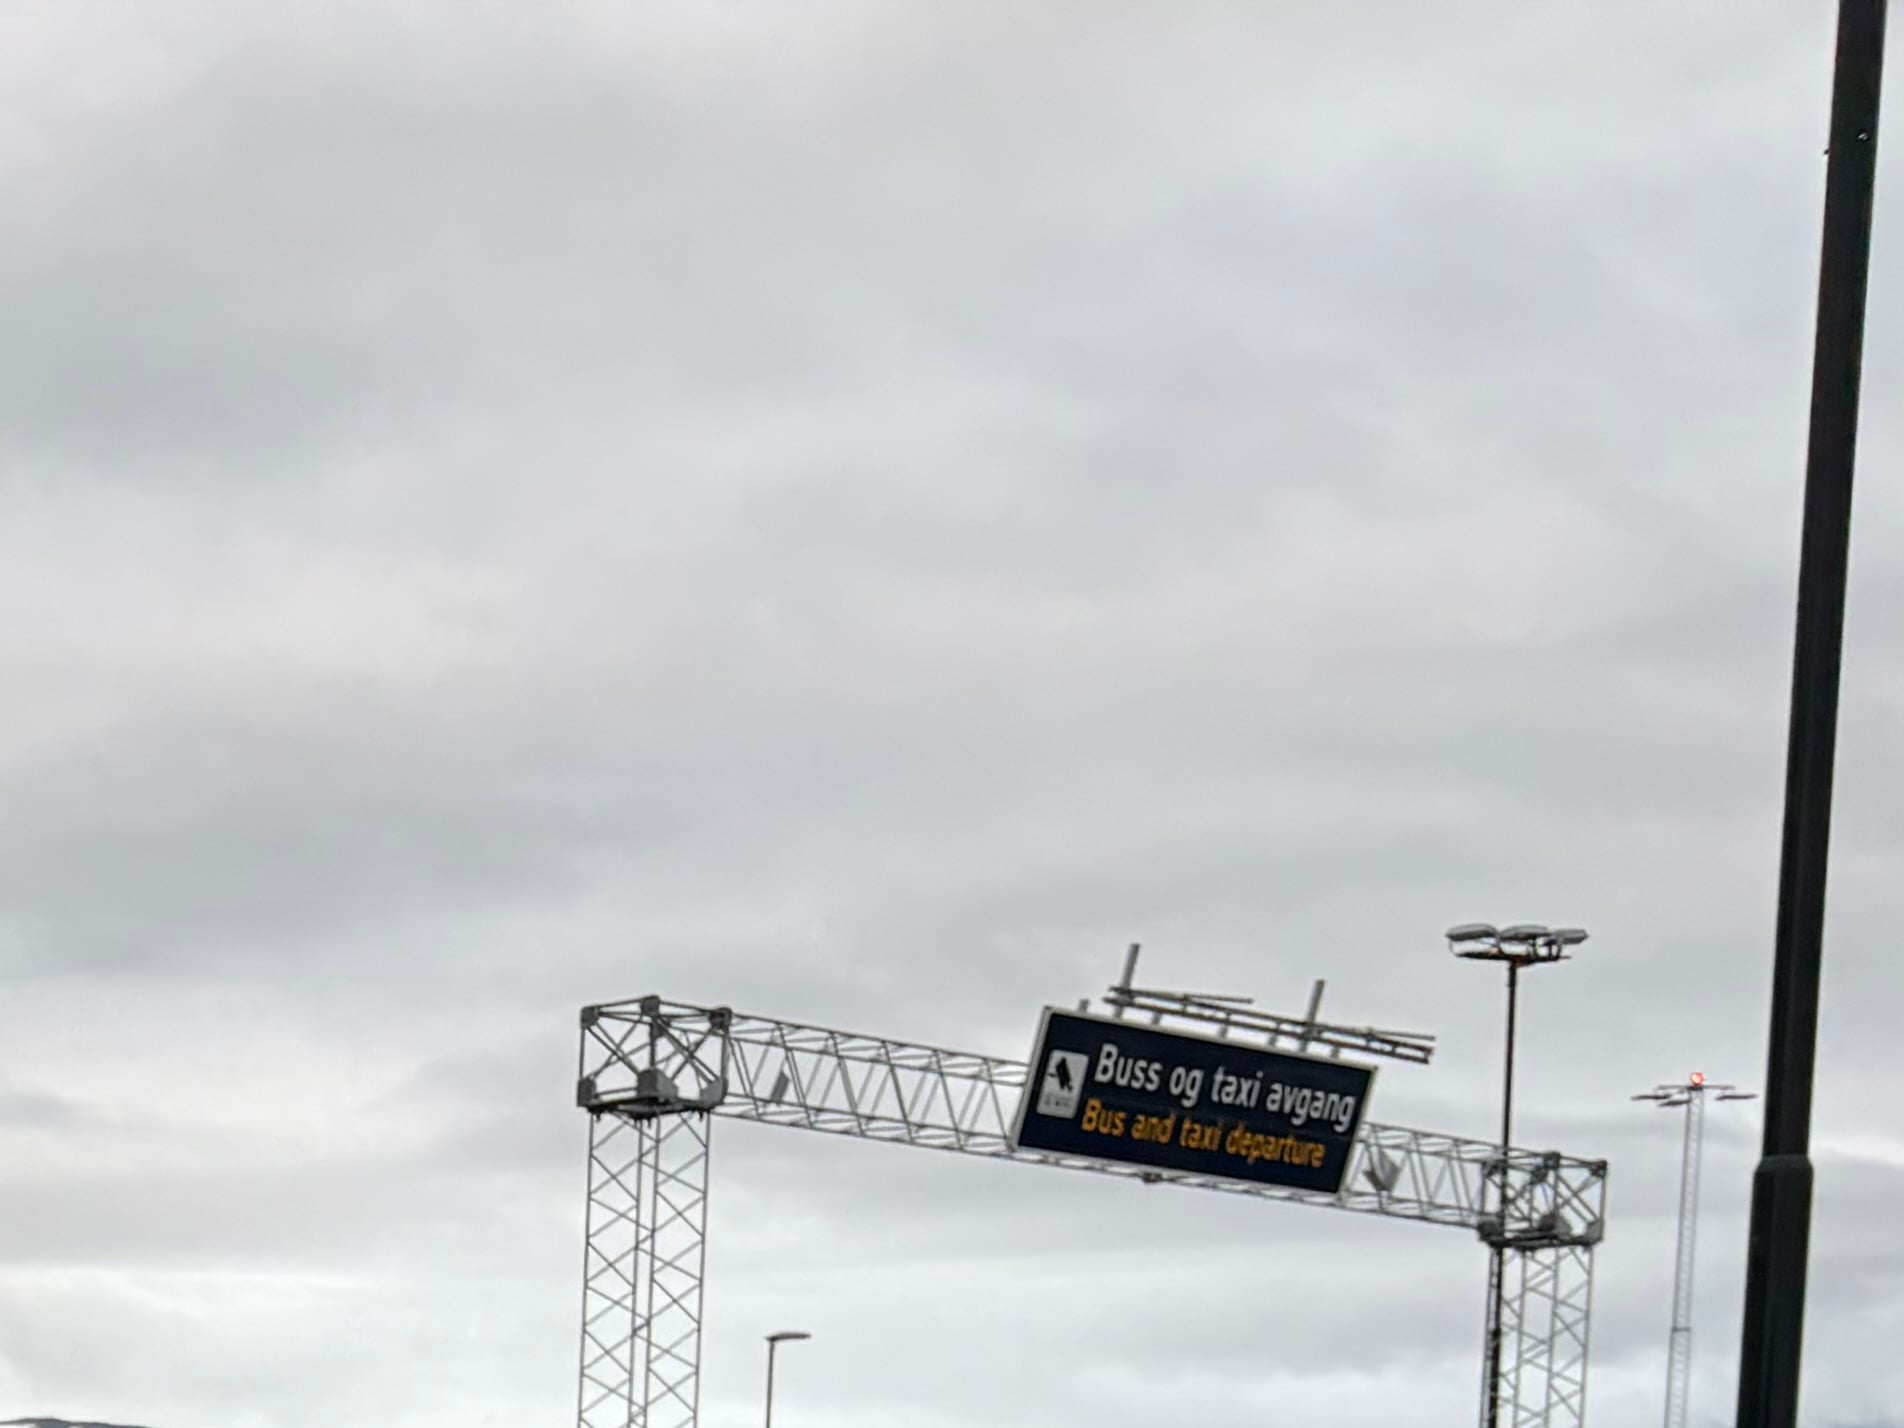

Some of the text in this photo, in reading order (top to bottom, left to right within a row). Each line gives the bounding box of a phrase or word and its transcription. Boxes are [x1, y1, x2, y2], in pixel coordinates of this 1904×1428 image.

[1094, 1043, 1357, 1133] Buss og taxi avgang
[1081, 1098, 1126, 1137] Bus
[1131, 1110, 1176, 1144] and
[1180, 1115, 1224, 1151] taxi
[1225, 1122, 1326, 1169] departure
